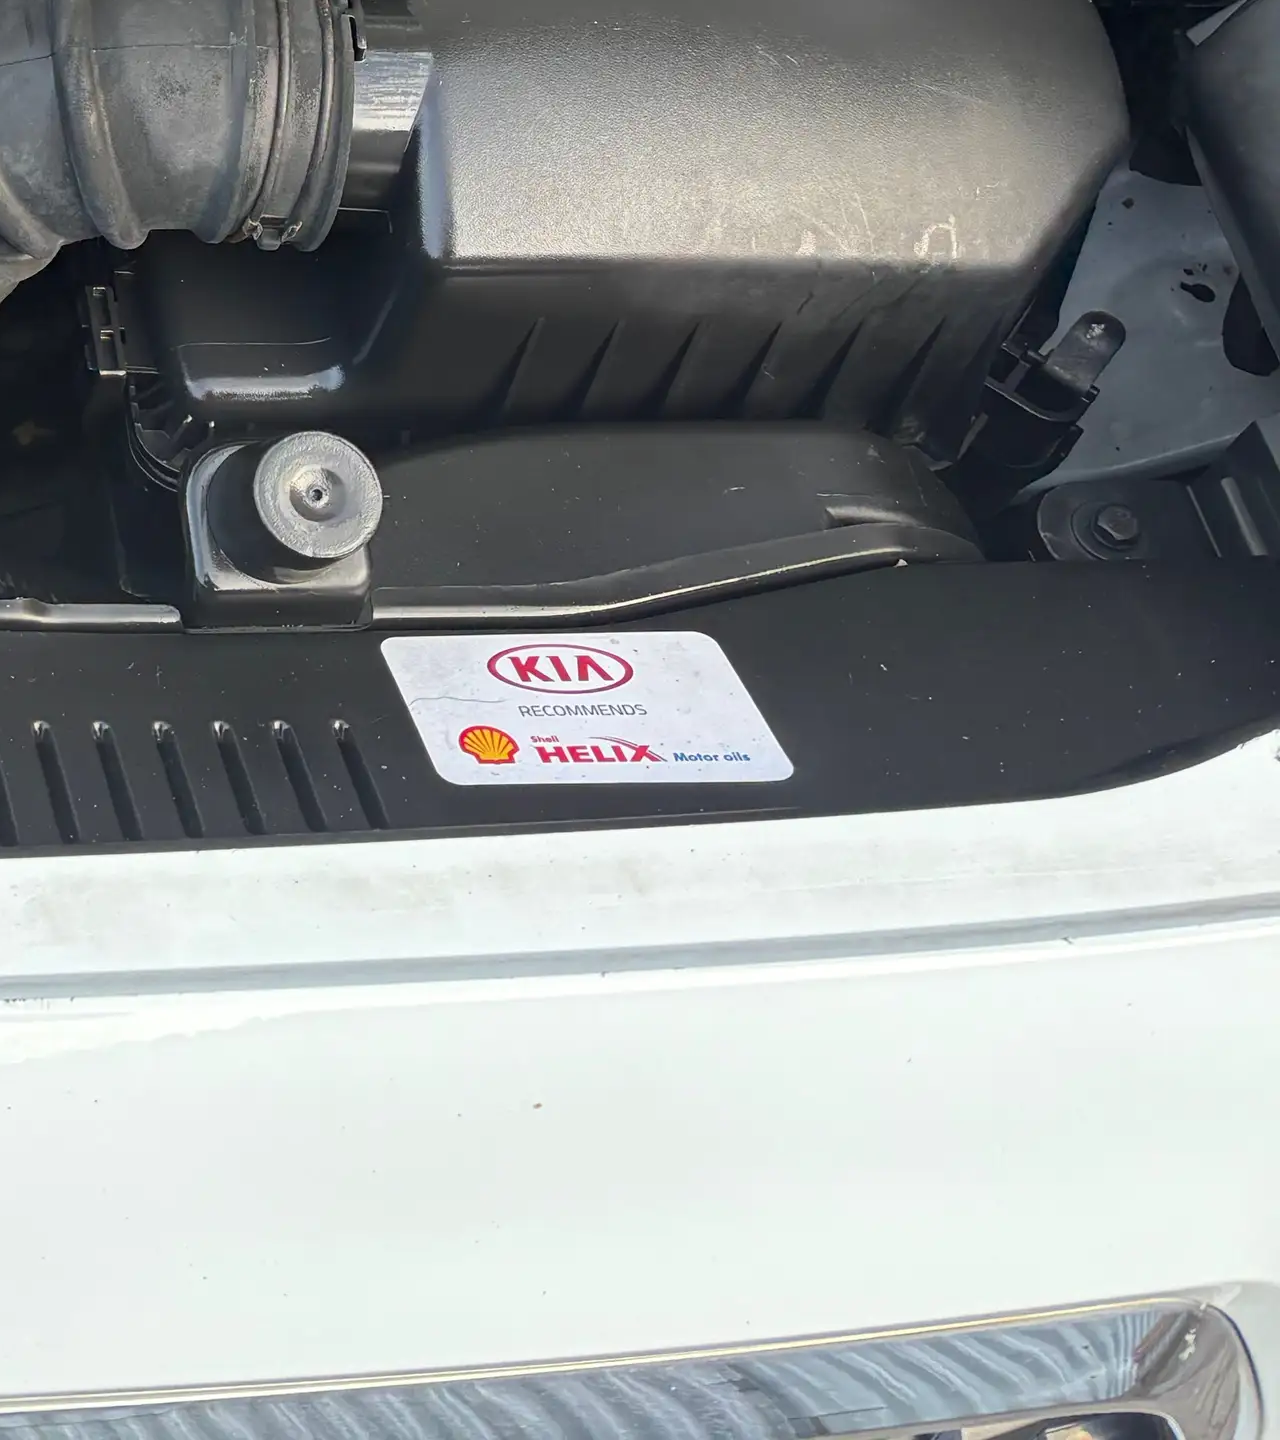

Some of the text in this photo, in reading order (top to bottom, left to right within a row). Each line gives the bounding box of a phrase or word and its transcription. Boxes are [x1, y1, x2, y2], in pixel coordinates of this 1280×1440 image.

[508, 654, 615, 683] KIA
[517, 702, 648, 719] RECOMMENDS
[530, 733, 560, 744] Shell
[534, 742, 752, 764] HELIX Motor oils
